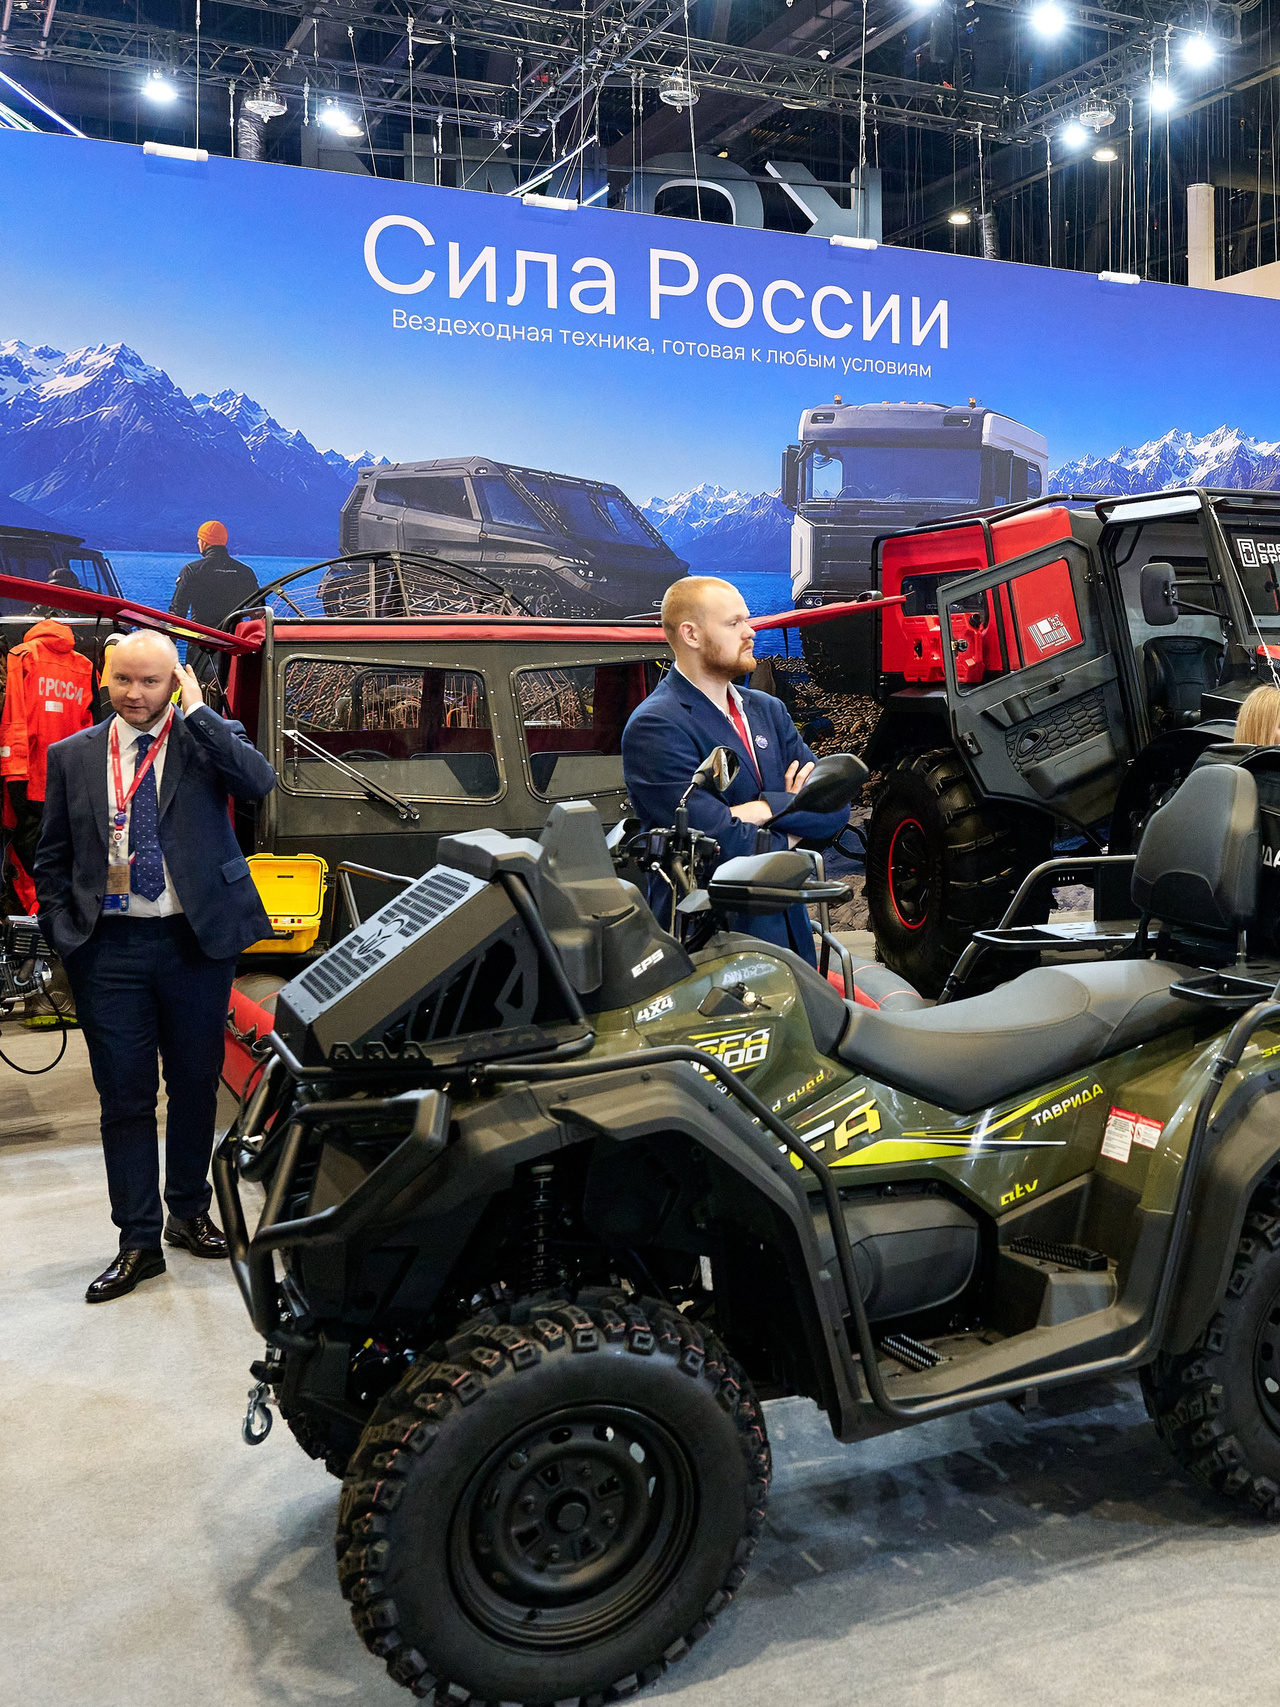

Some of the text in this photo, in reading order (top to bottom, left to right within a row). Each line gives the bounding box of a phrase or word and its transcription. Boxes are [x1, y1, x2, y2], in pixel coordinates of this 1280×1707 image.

[364, 214, 949, 349] Сила России
[392, 308, 932, 378] Вездеходная техника, готовая к любым условиям
[1260, 554, 1270, 564] В
[631, 948, 665, 978] EPS
[1031, 1083, 1104, 1127] ТАВРИДА
[1000, 1179, 1038, 1206] atv
